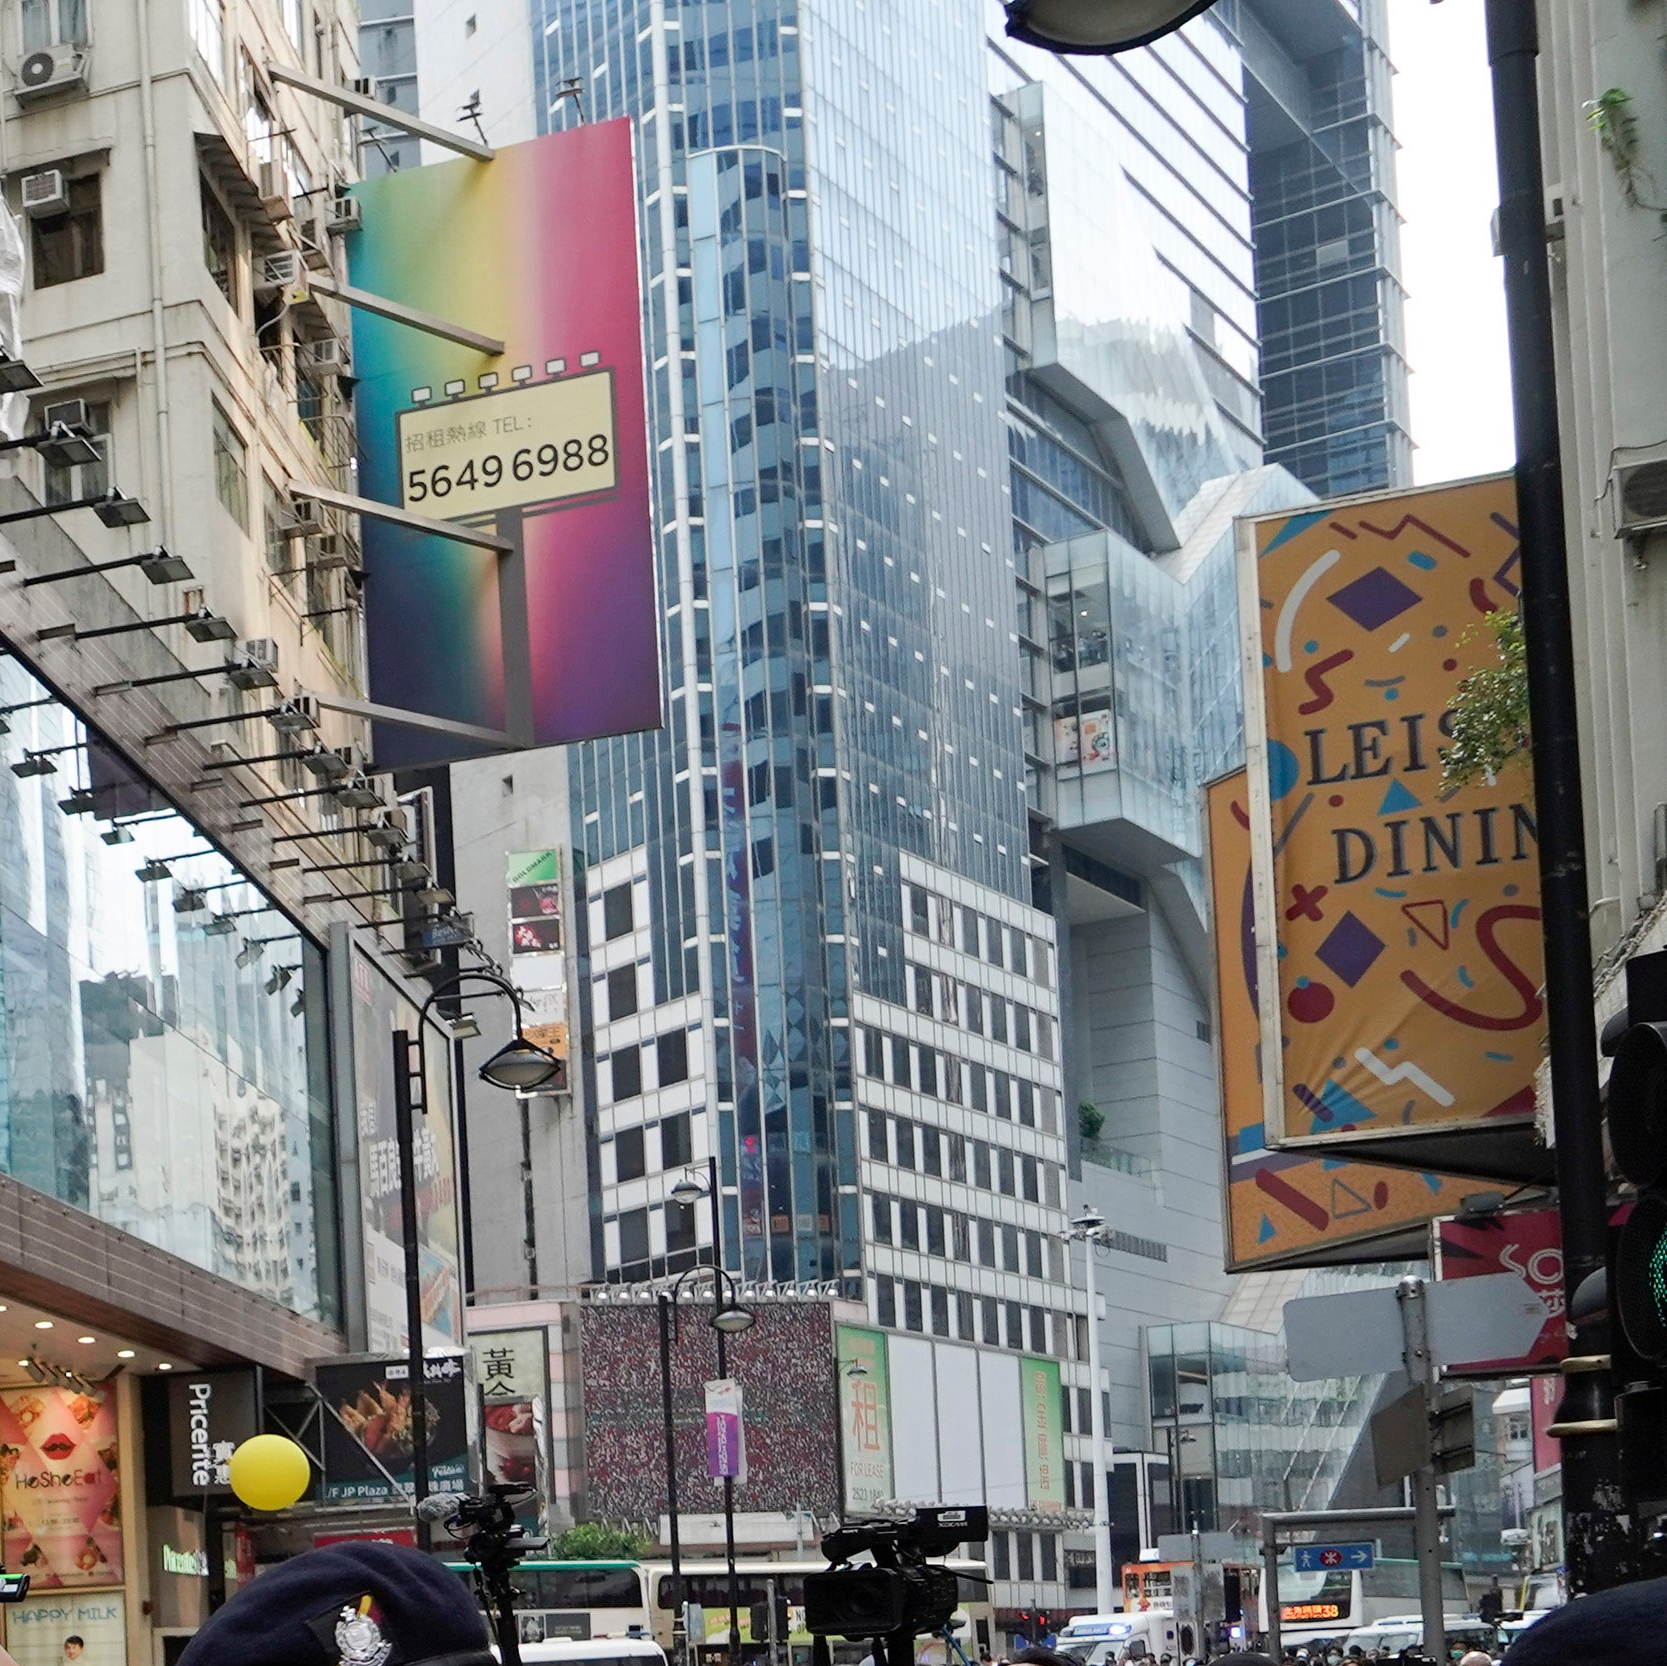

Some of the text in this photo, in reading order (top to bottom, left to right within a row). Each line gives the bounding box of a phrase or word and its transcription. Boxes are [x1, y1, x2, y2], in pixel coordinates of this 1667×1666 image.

[407, 433, 610, 503] 5649 6988
[188, 1383, 212, 1487] Pricerite
[15, 1469, 103, 1491] HeSheEat
[11, 1605, 118, 1626] HAPPY MILK
